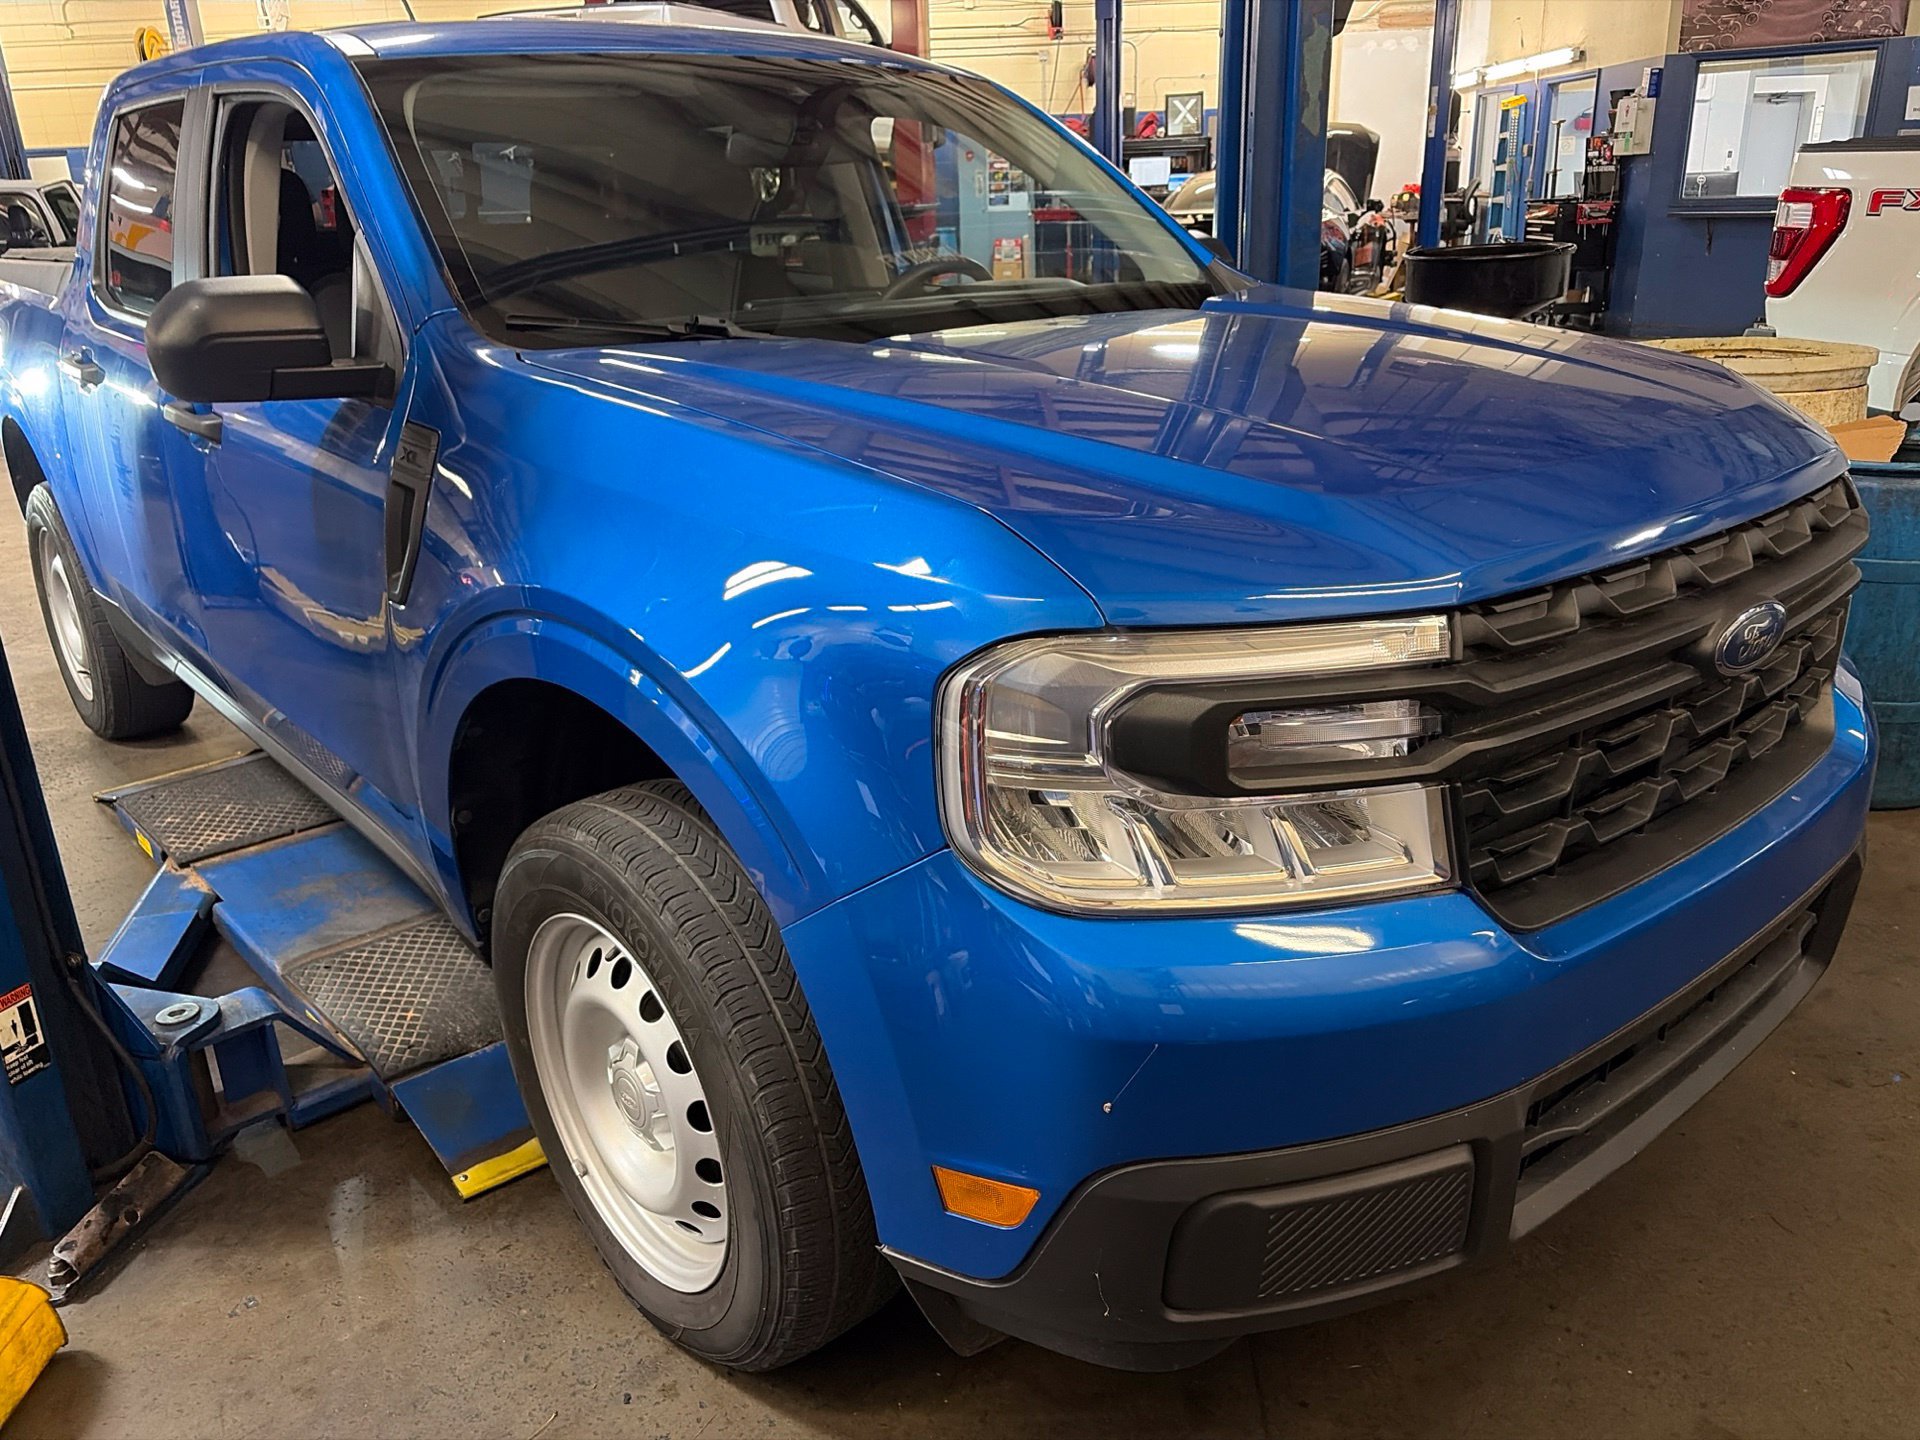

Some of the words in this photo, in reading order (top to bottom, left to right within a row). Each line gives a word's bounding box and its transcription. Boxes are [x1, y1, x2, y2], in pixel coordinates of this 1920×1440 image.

[1738, 616, 1779, 663] Ford
[602, 888, 701, 1050] YOKOHAMA
[0, 985, 31, 1008] WARNING
